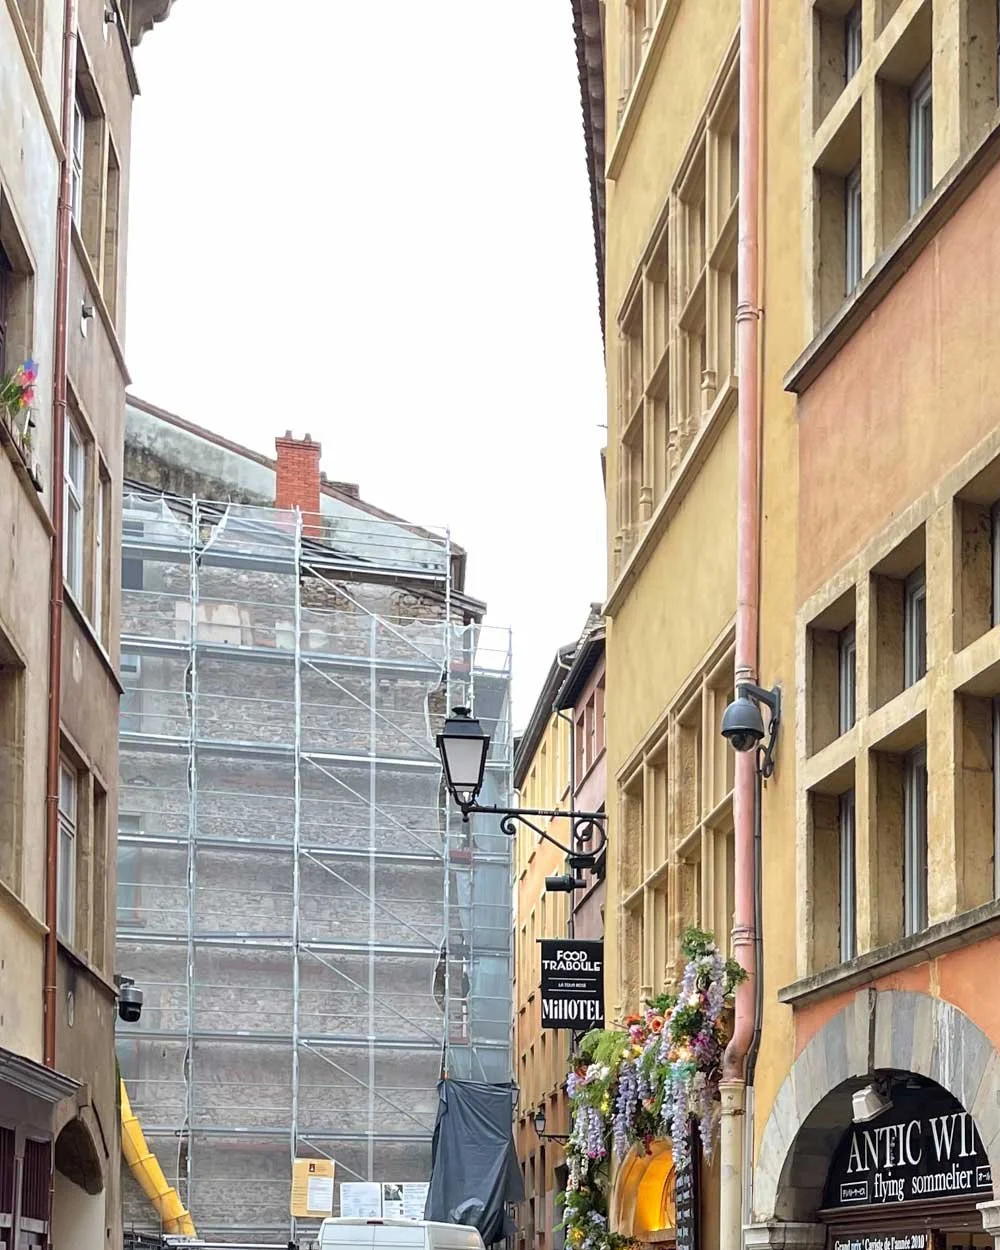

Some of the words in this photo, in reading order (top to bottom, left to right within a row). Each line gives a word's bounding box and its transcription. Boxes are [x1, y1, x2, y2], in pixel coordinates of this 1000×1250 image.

[556, 950, 588, 962] FOOD
[542, 960, 601, 972] TRABOULE
[846, 1120, 922, 1173] ANTIC
[874, 1171, 905, 1203] flying
[912, 1163, 973, 1194] sommelier
[884, 1237, 891, 1250] de
